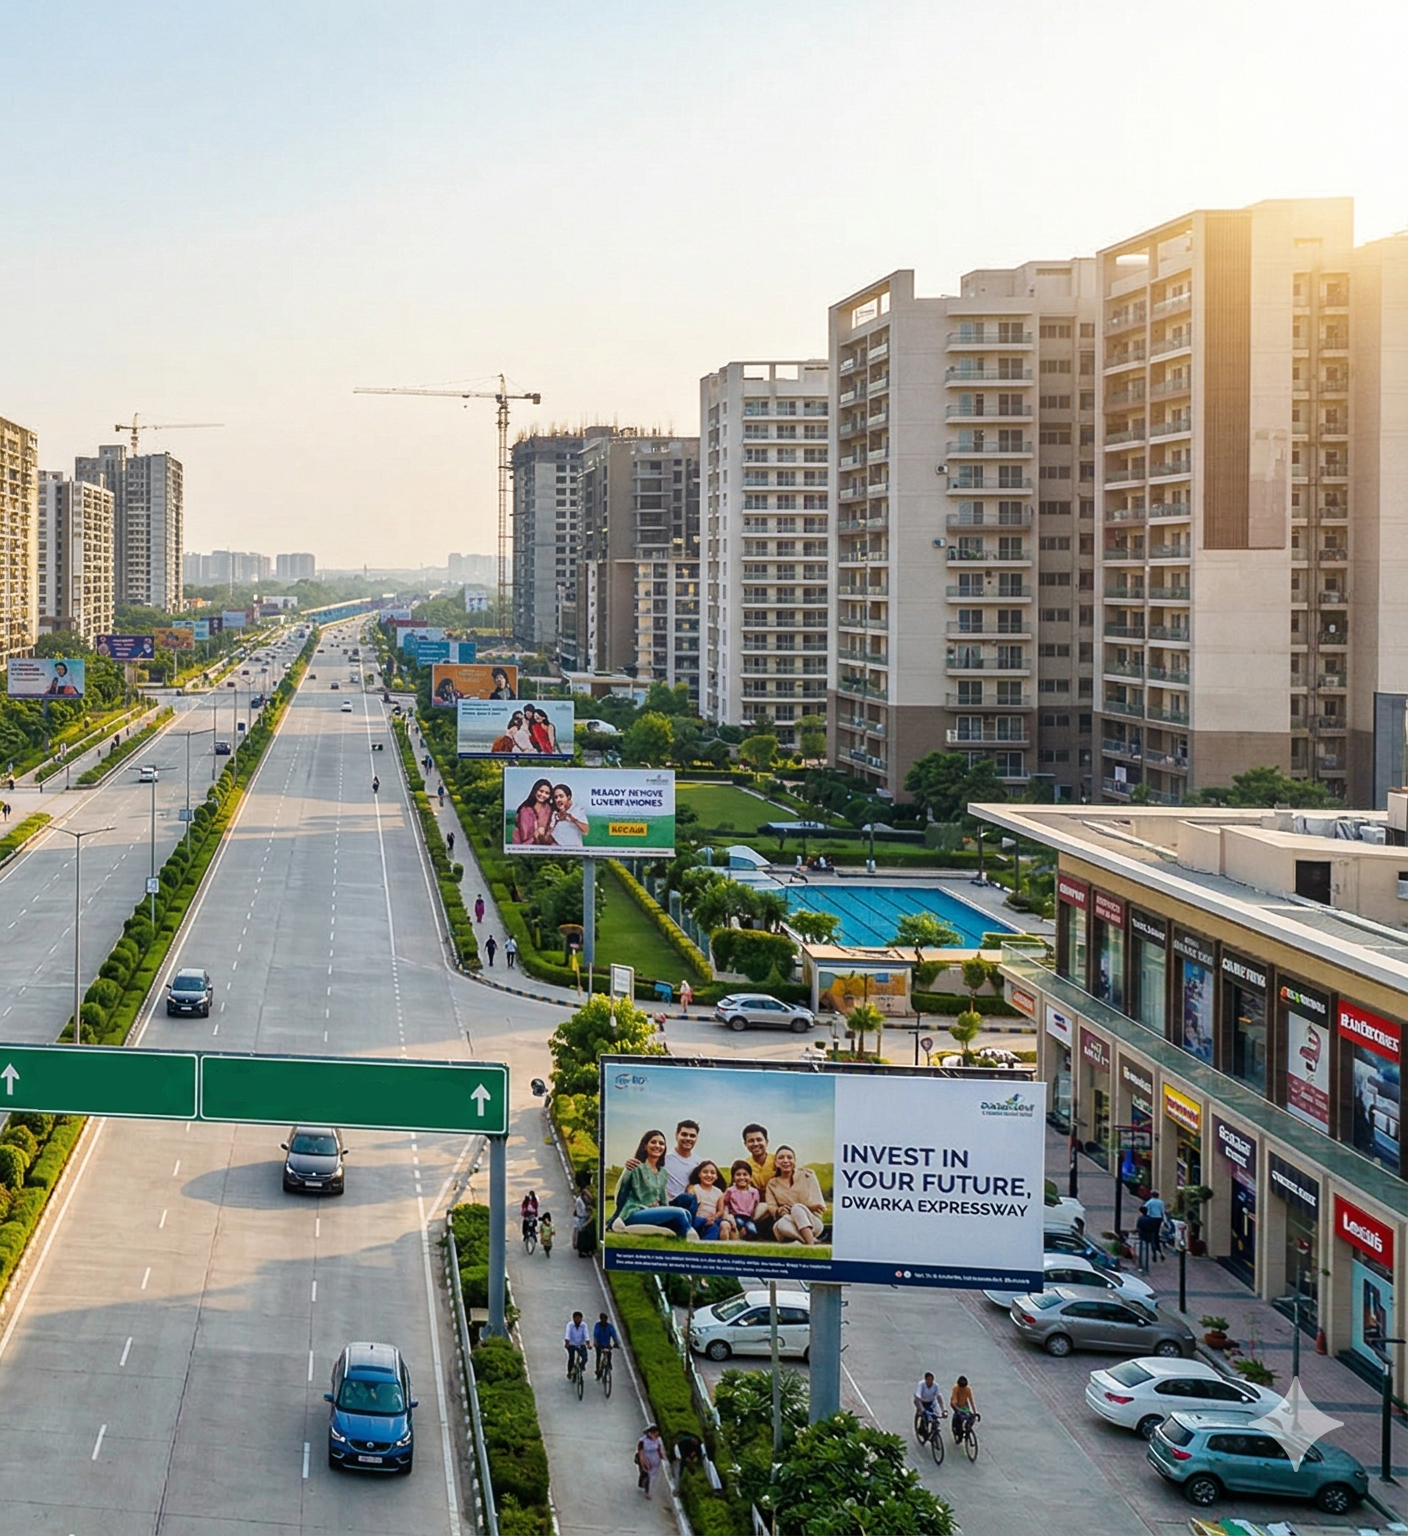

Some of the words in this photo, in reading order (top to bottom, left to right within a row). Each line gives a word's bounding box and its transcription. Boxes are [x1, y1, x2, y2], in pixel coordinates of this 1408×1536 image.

[842, 1144, 935, 1167] INVEST
[942, 1149, 969, 1169] IN
[841, 1169, 914, 1192] YOUR
[922, 1173, 1032, 1200] FUTURE,
[841, 1195, 914, 1213] DWARKA
[917, 1200, 1029, 1217] EXPRESSWAY
